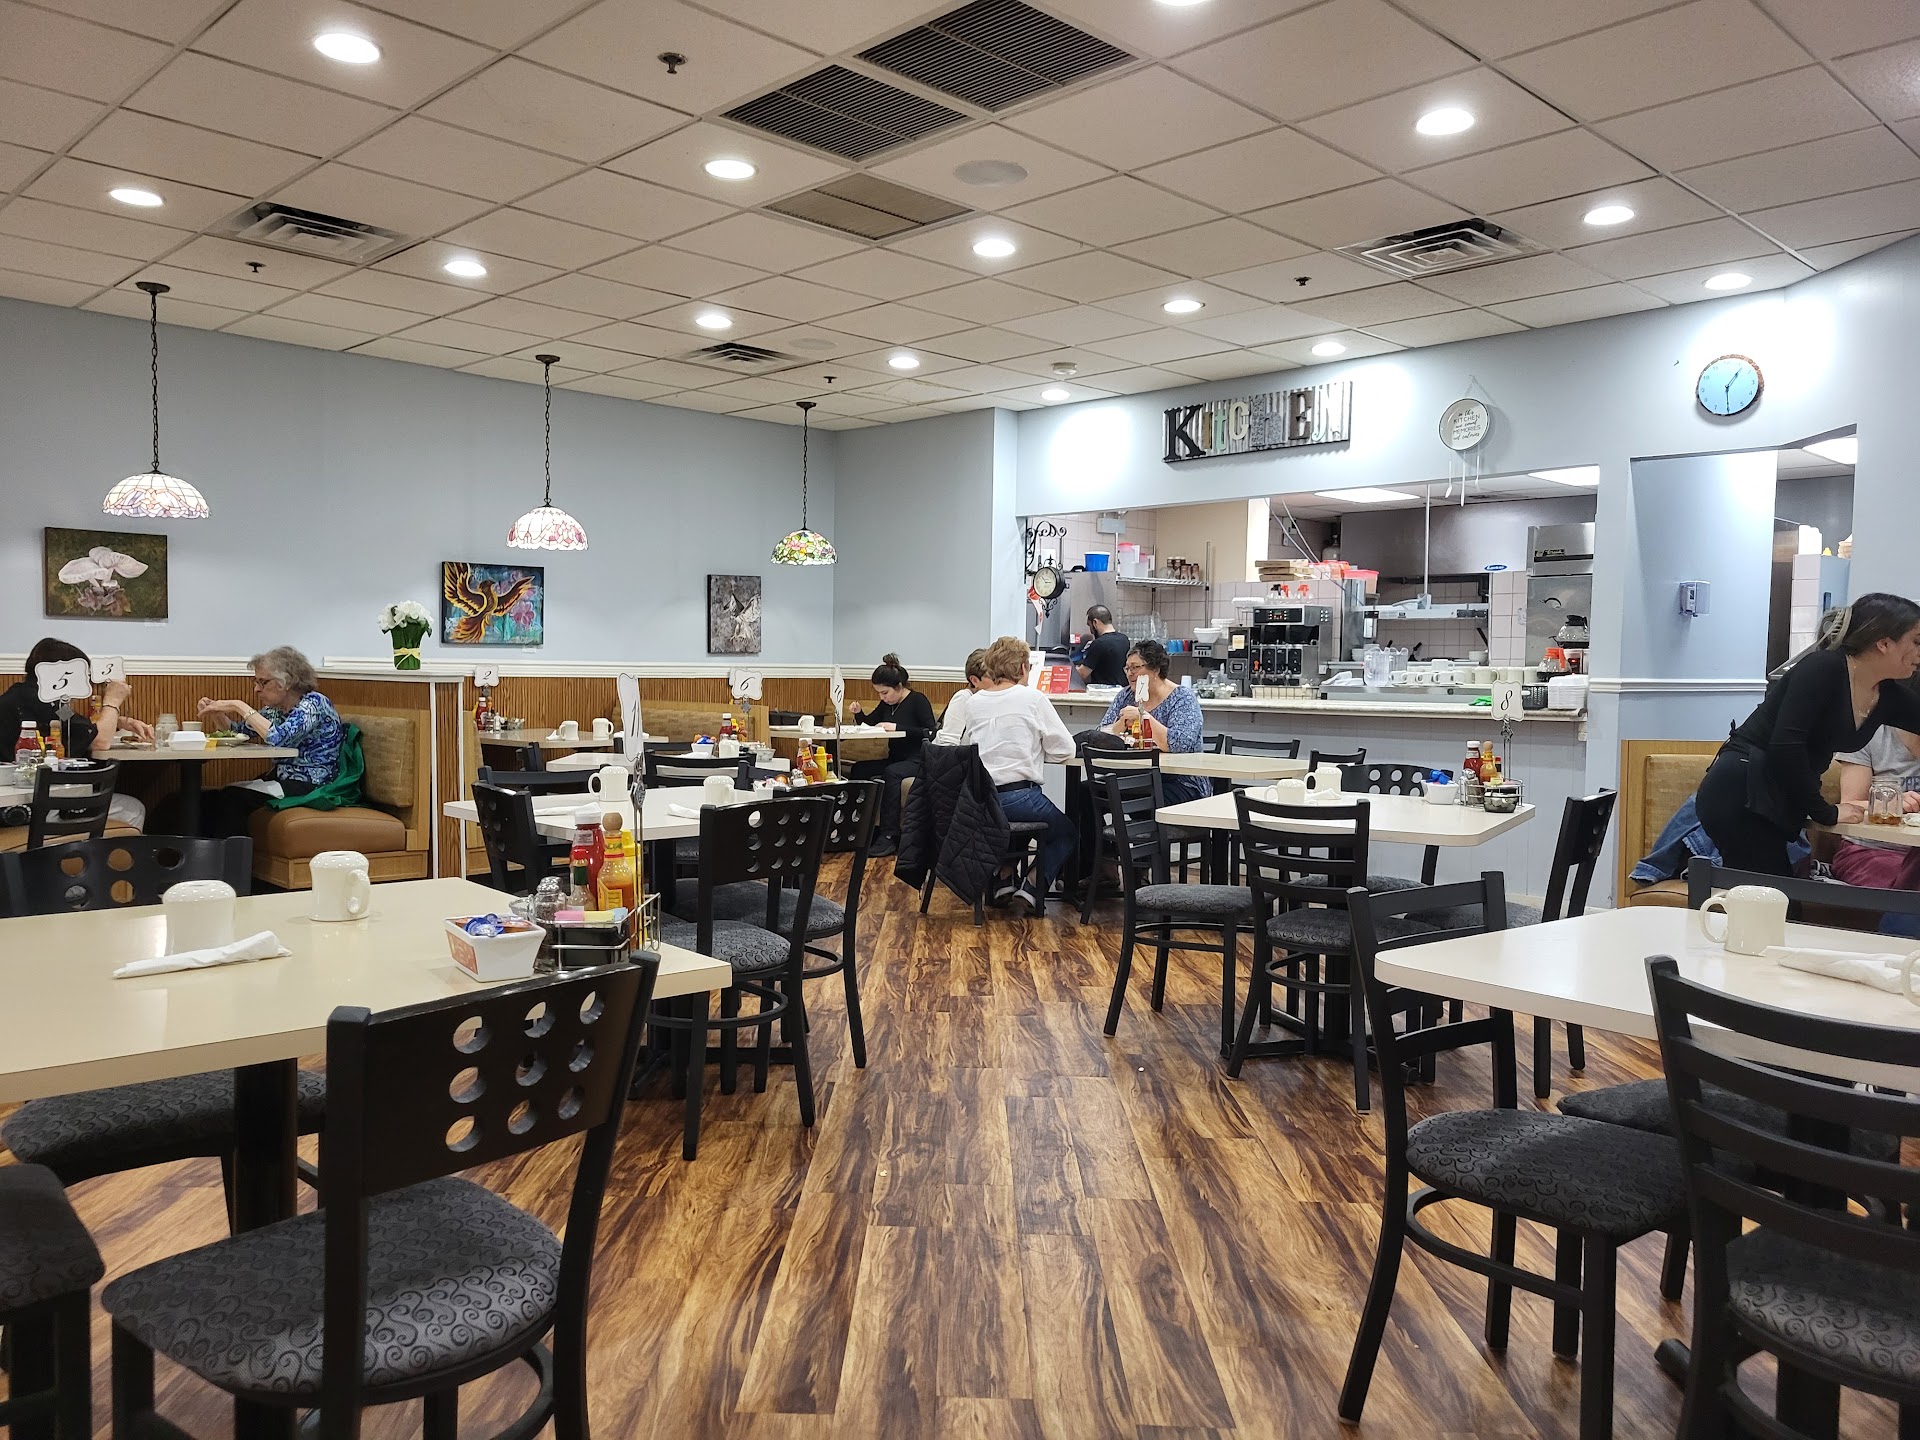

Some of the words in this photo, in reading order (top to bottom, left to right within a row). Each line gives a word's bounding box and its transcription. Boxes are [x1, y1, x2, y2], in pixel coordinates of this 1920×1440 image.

[1453, 413, 1480, 424] KITCHEN
[1453, 425, 1481, 434] MEMORIES
[101, 663, 114, 675] 3
[482, 670, 492, 680] 2
[52, 671, 74, 690] 5
[740, 676, 756, 691] 6
[834, 684, 842, 703] 10
[1139, 682, 1145, 695] 7
[1500, 689, 1513, 711] 8
